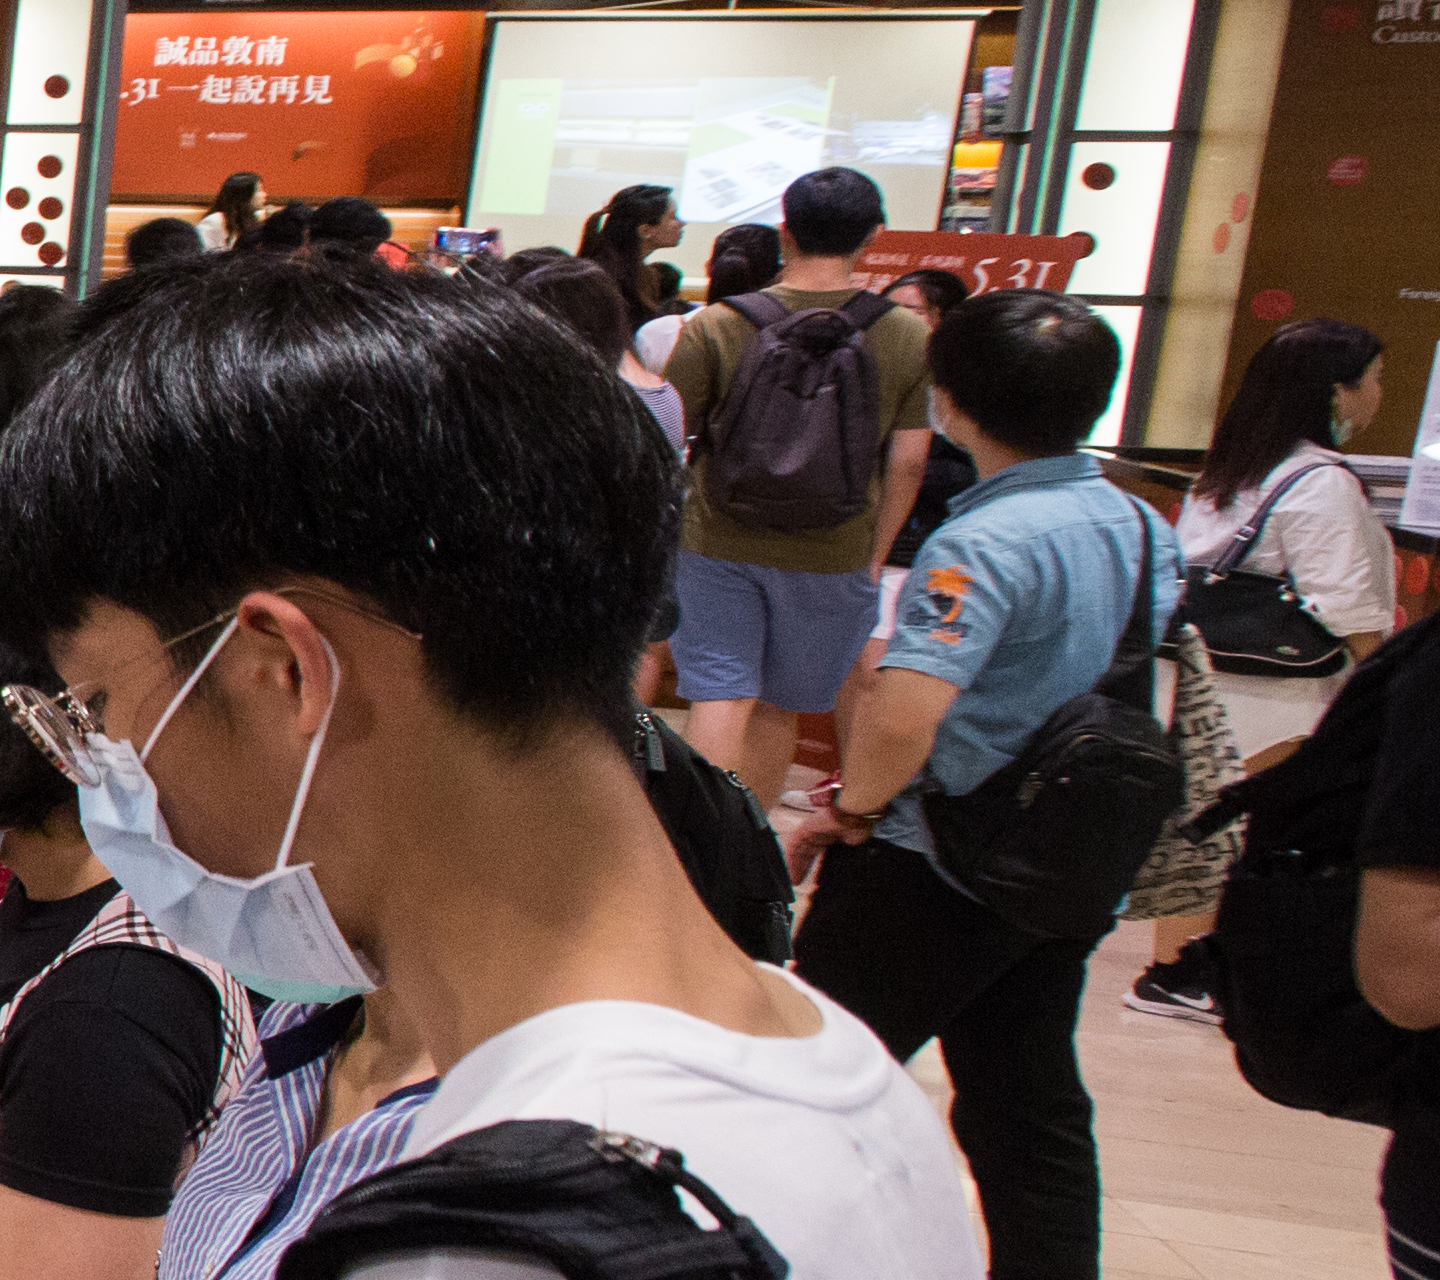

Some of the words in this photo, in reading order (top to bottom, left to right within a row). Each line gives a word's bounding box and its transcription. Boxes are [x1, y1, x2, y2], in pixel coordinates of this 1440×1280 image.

[154, 35, 289, 67] 誠品敦南
[165, 72, 336, 107] 一起說再見
[968, 257, 1060, 299] 5.31
